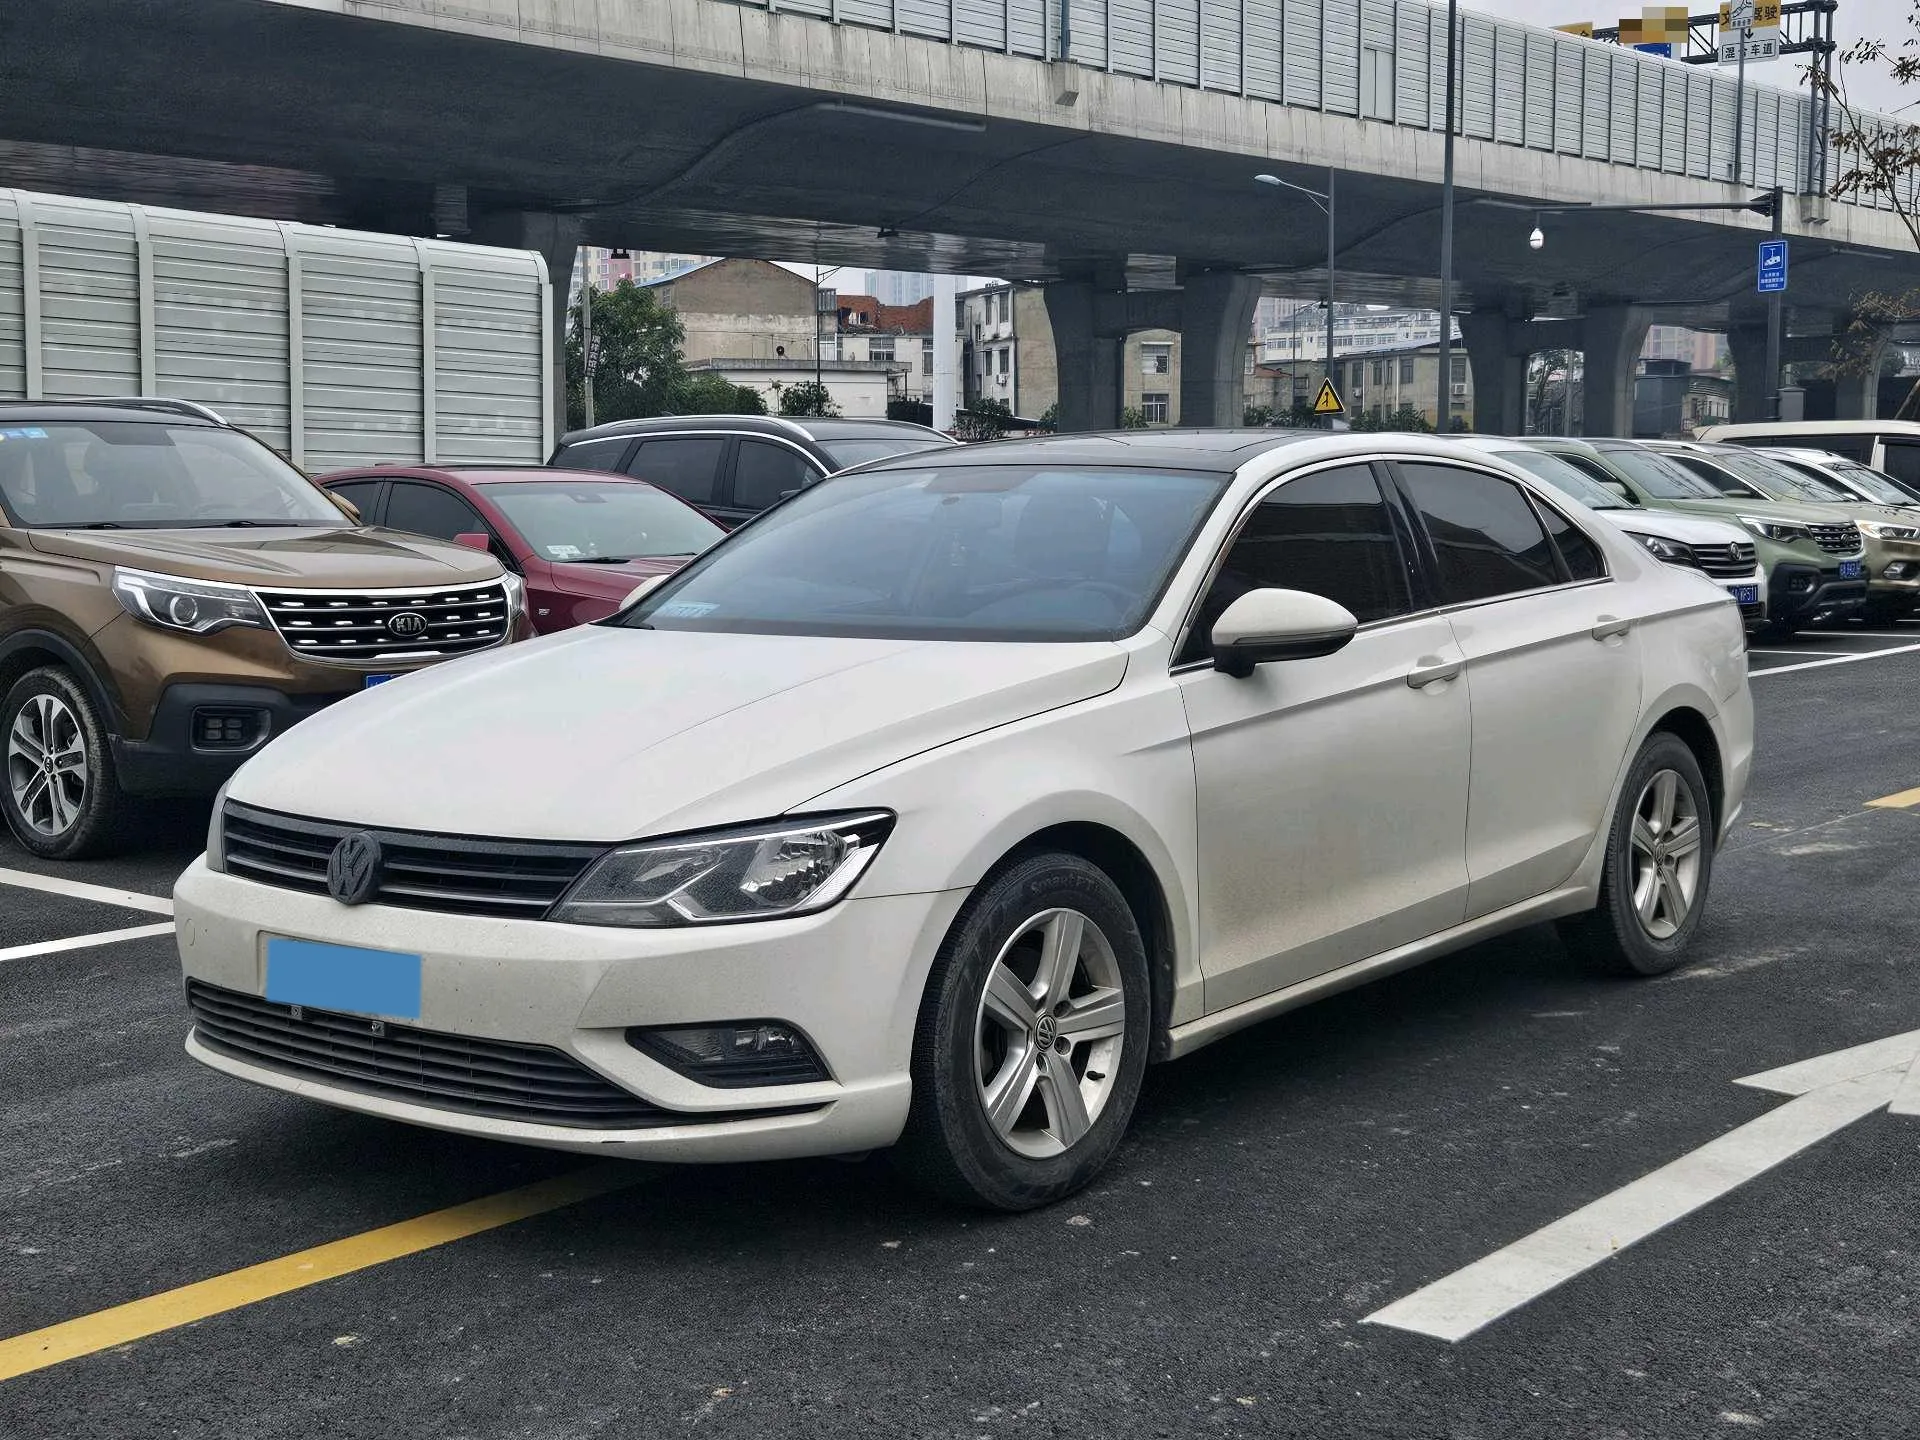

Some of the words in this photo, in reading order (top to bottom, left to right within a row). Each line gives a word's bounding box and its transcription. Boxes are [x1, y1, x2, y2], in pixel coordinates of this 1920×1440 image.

[1721, 5, 1778, 25] 文驾驶
[395, 617, 422, 632] KIA
